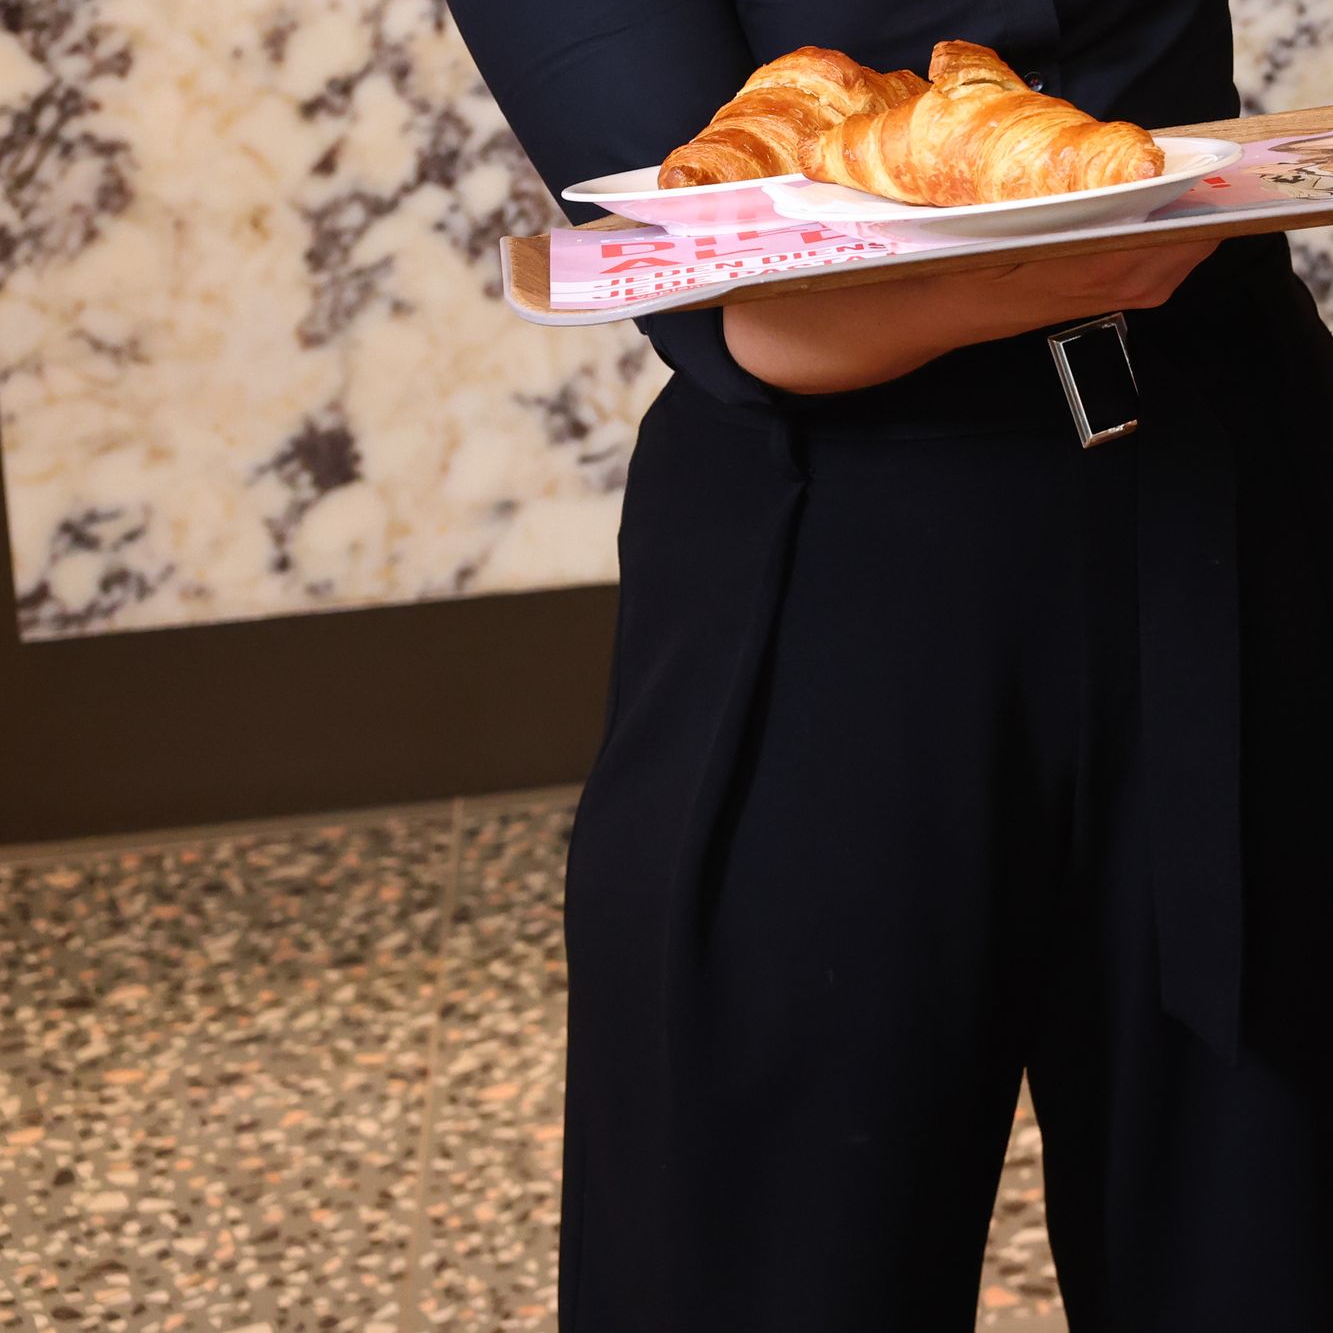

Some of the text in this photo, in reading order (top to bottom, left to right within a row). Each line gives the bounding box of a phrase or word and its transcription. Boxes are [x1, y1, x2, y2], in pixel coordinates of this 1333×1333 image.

[594, 242, 887, 288] JEDEN DIENS
[592, 275, 713, 299] JEDE
